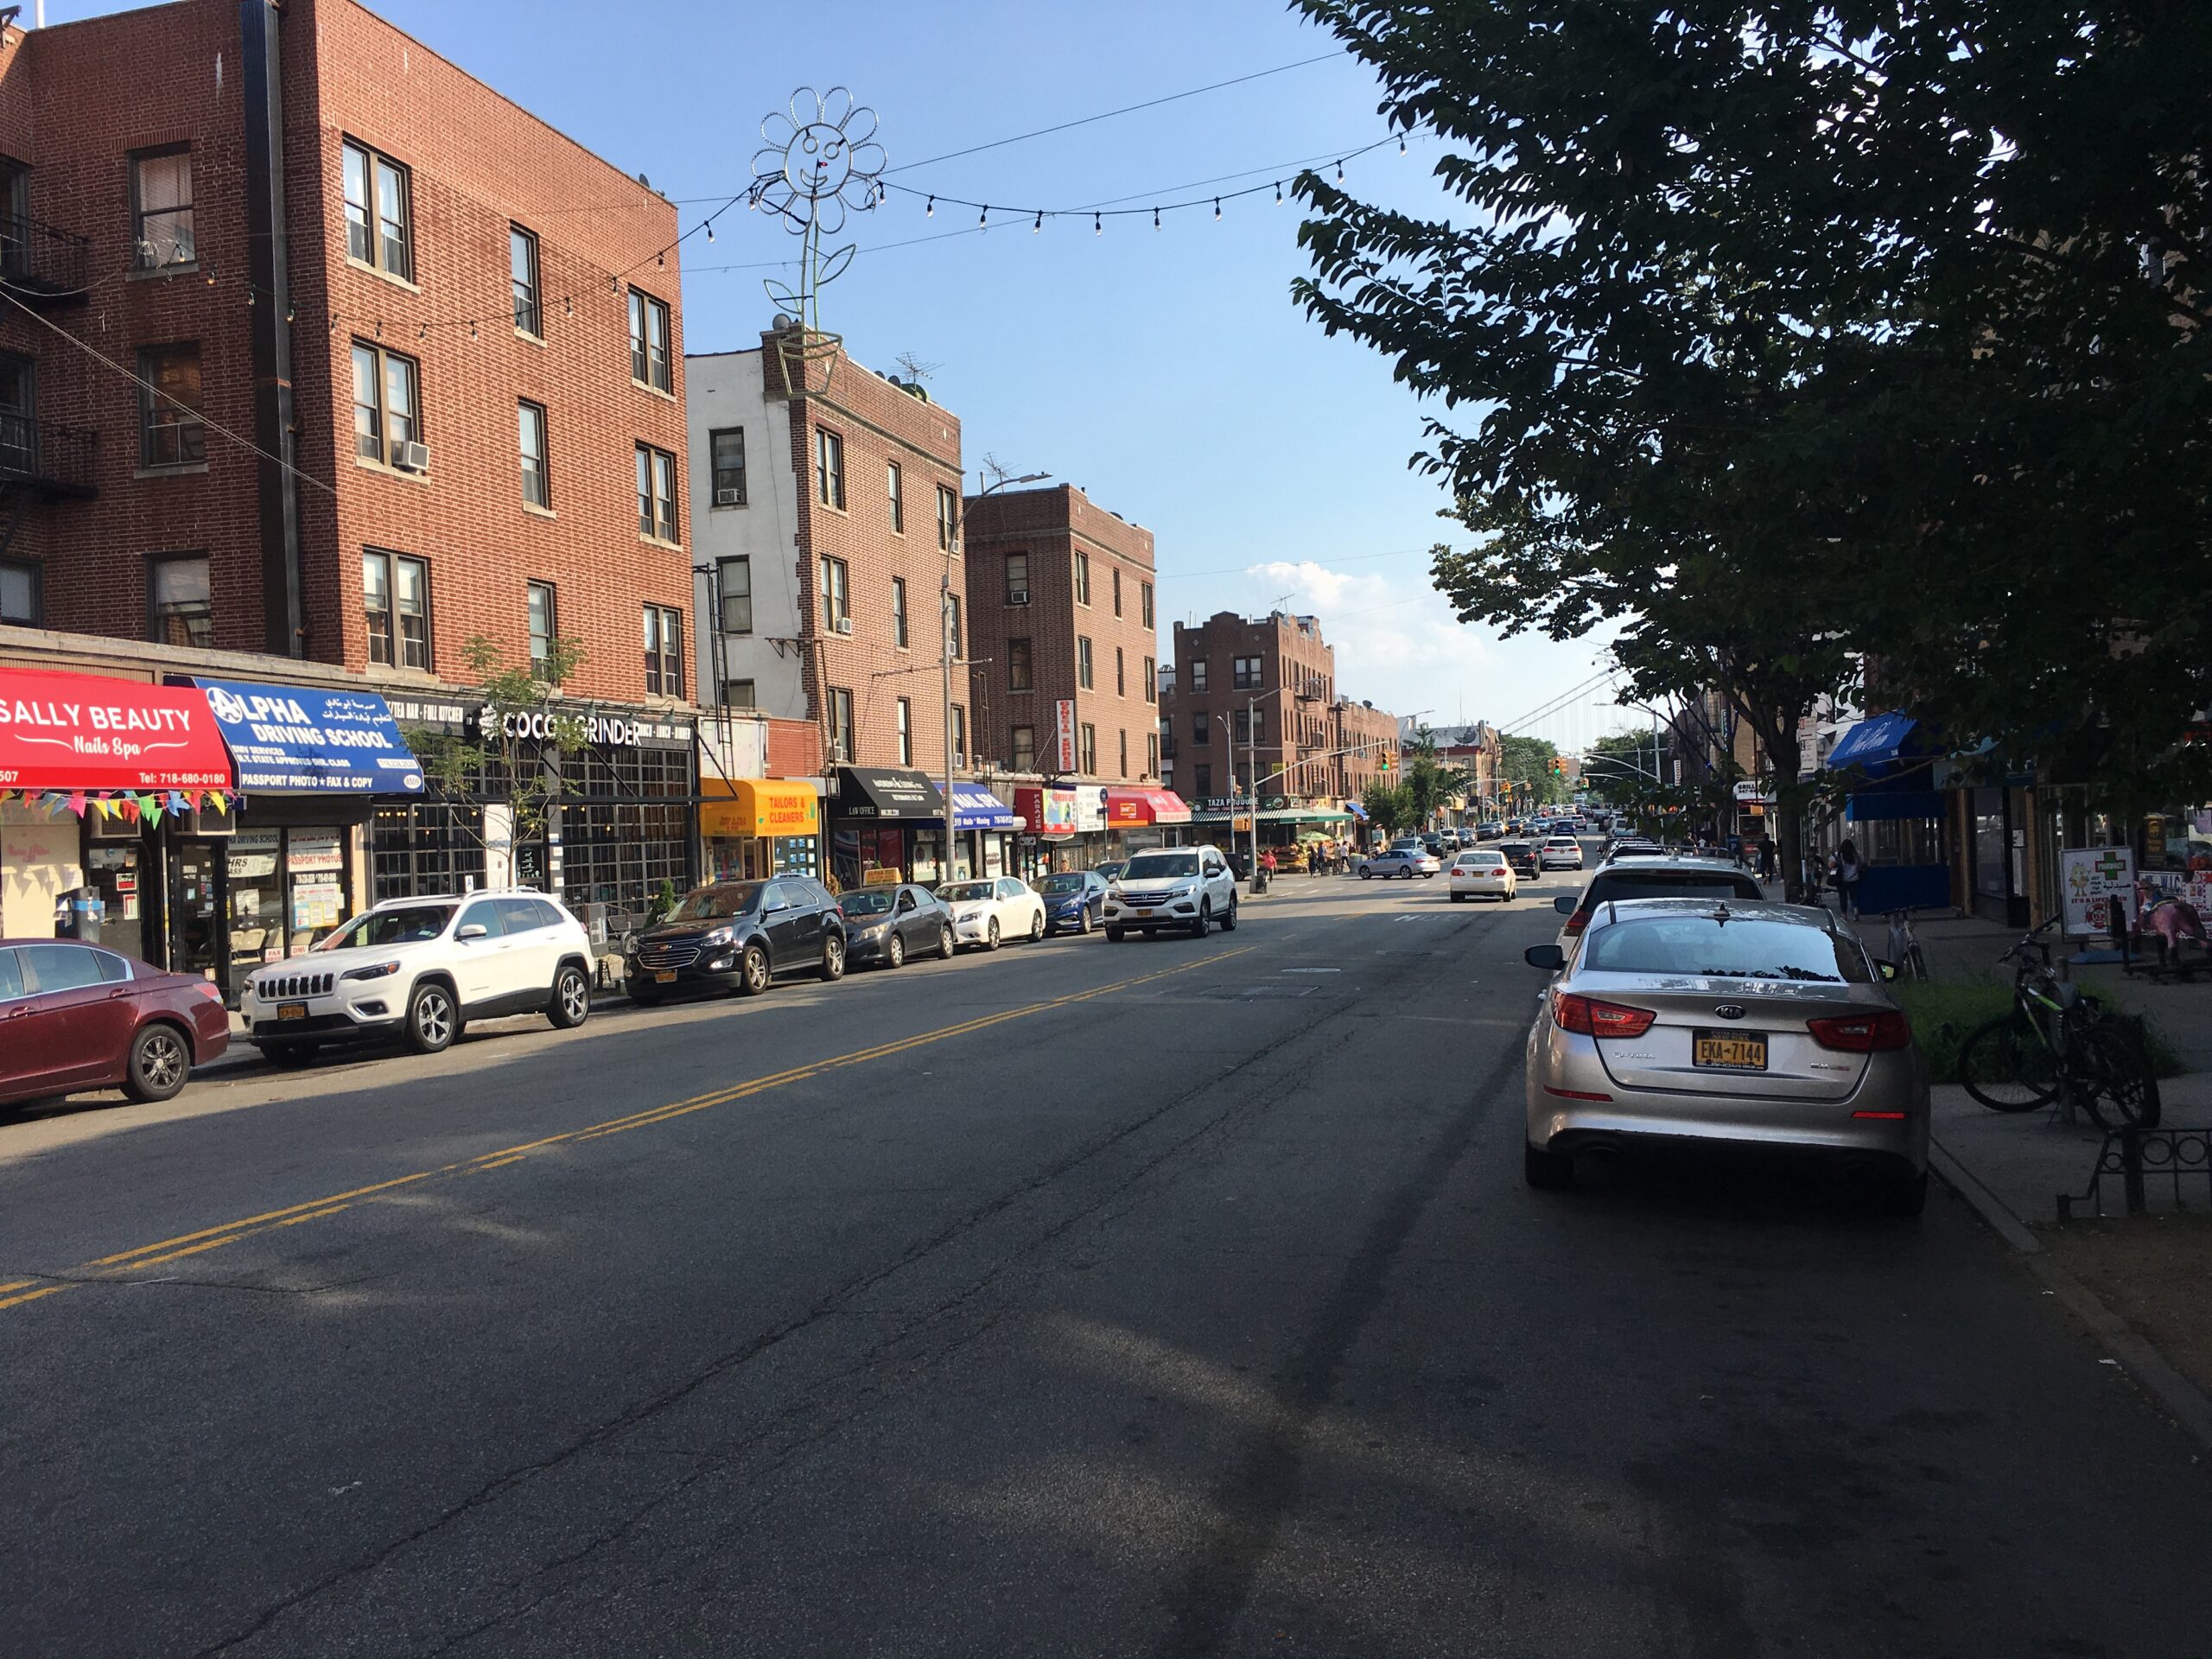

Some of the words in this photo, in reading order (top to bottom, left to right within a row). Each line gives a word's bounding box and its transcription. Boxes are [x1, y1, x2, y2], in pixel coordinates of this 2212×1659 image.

[207, 687, 312, 724] ALPHA
[0, 698, 80, 726] SALLY
[88, 707, 190, 731] BEAUTY
[406, 702, 418, 719] BAR
[423, 704, 437, 721] FULL
[438, 705, 464, 722] KITCHEN
[504, 711, 567, 740] COCO
[251, 724, 326, 745] DRIVING
[325, 728, 393, 748] SCHOOL
[73, 735, 110, 755] Nails
[113, 737, 141, 760] Spa
[0, 771, 18, 782] 507
[139, 772, 156, 784] Tel:
[160, 772, 225, 784] 718-680-0180
[242, 773, 288, 785] PASSPORT
[289, 775, 318, 787] PHOTO
[326, 777, 341, 788] FAX
[344, 778, 350, 787] &
[352, 778, 373, 788] COPY
[769, 797, 798, 810] TAILORS
[800, 796, 805, 808] &
[1226, 798, 1259, 806] PODUE
[849, 807, 860, 816] LAW
[860, 806, 875, 815] OFFICE
[769, 812, 804, 823] CLEANERS
[237, 835, 258, 844] DRIVING
[259, 834, 279, 843] SCHOOL
[288, 854, 316, 865] PASSPORT
[913, 861, 933, 873] NAILS
[1720, 1007, 1742, 1016] KIA
